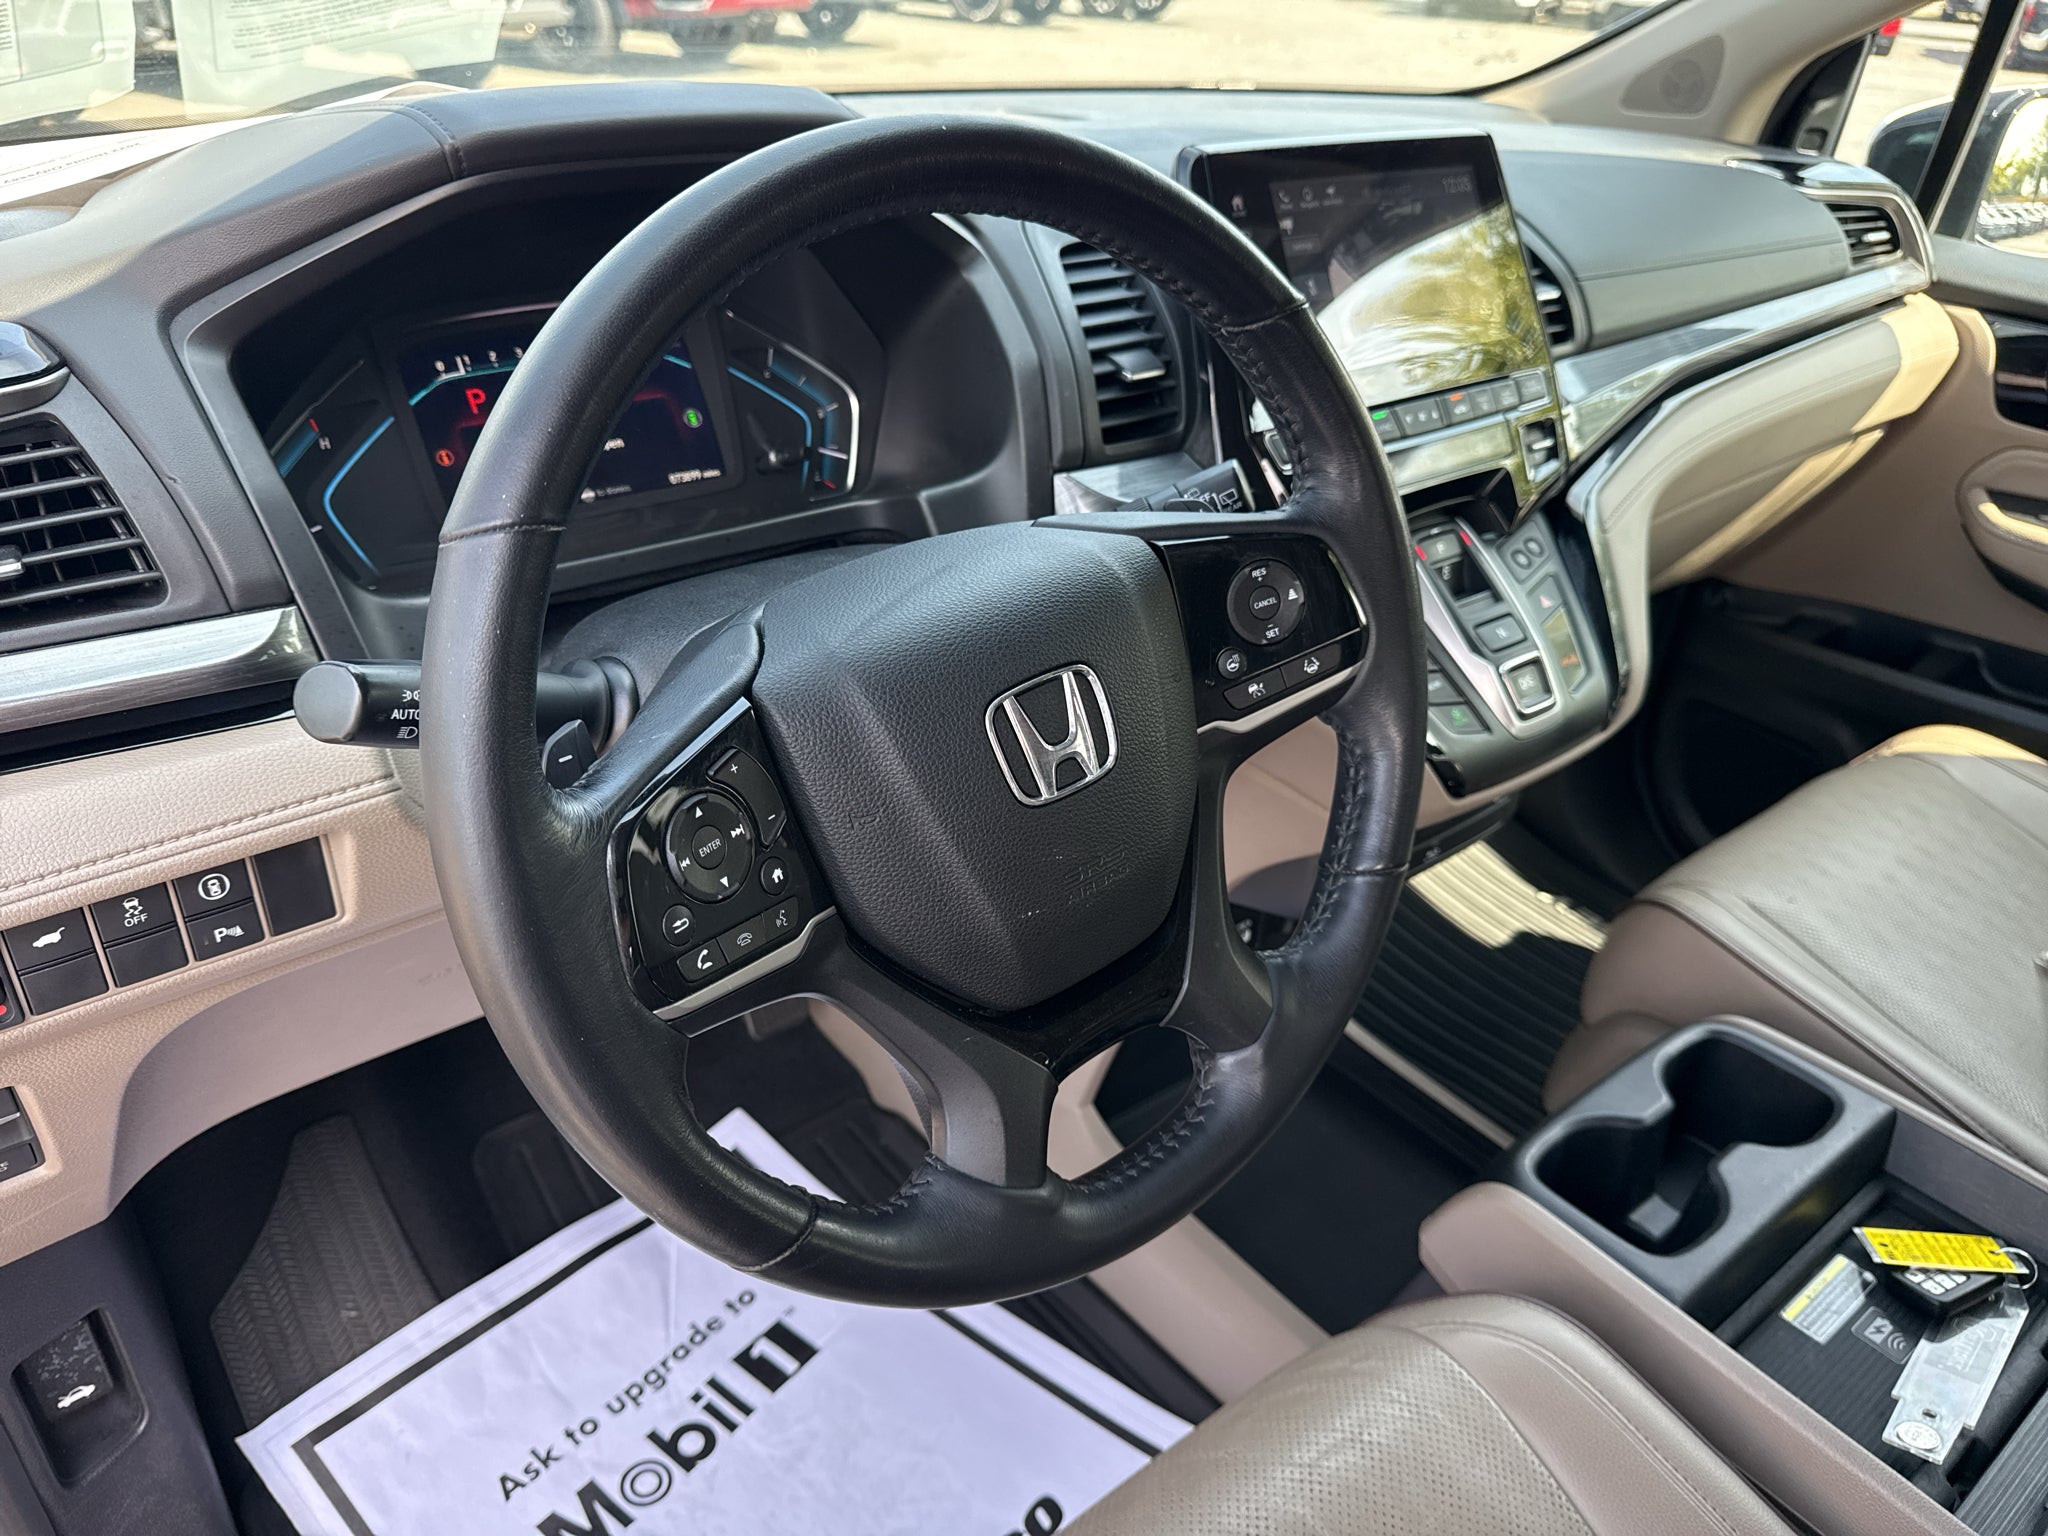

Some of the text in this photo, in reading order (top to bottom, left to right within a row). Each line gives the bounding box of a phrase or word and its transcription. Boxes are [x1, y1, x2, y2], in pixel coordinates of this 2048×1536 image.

[4, 164, 63, 185] Odyssey
[465, 388, 487, 415] P
[318, 436, 332, 450] H
[1251, 567, 1268, 579] RES
[1253, 596, 1278, 610] CANCEL
[1265, 626, 1280, 639] SET
[698, 838, 722, 858] ENTER
[124, 913, 148, 927] OFF
[499, 1288, 758, 1502] Ask to upgrade to
